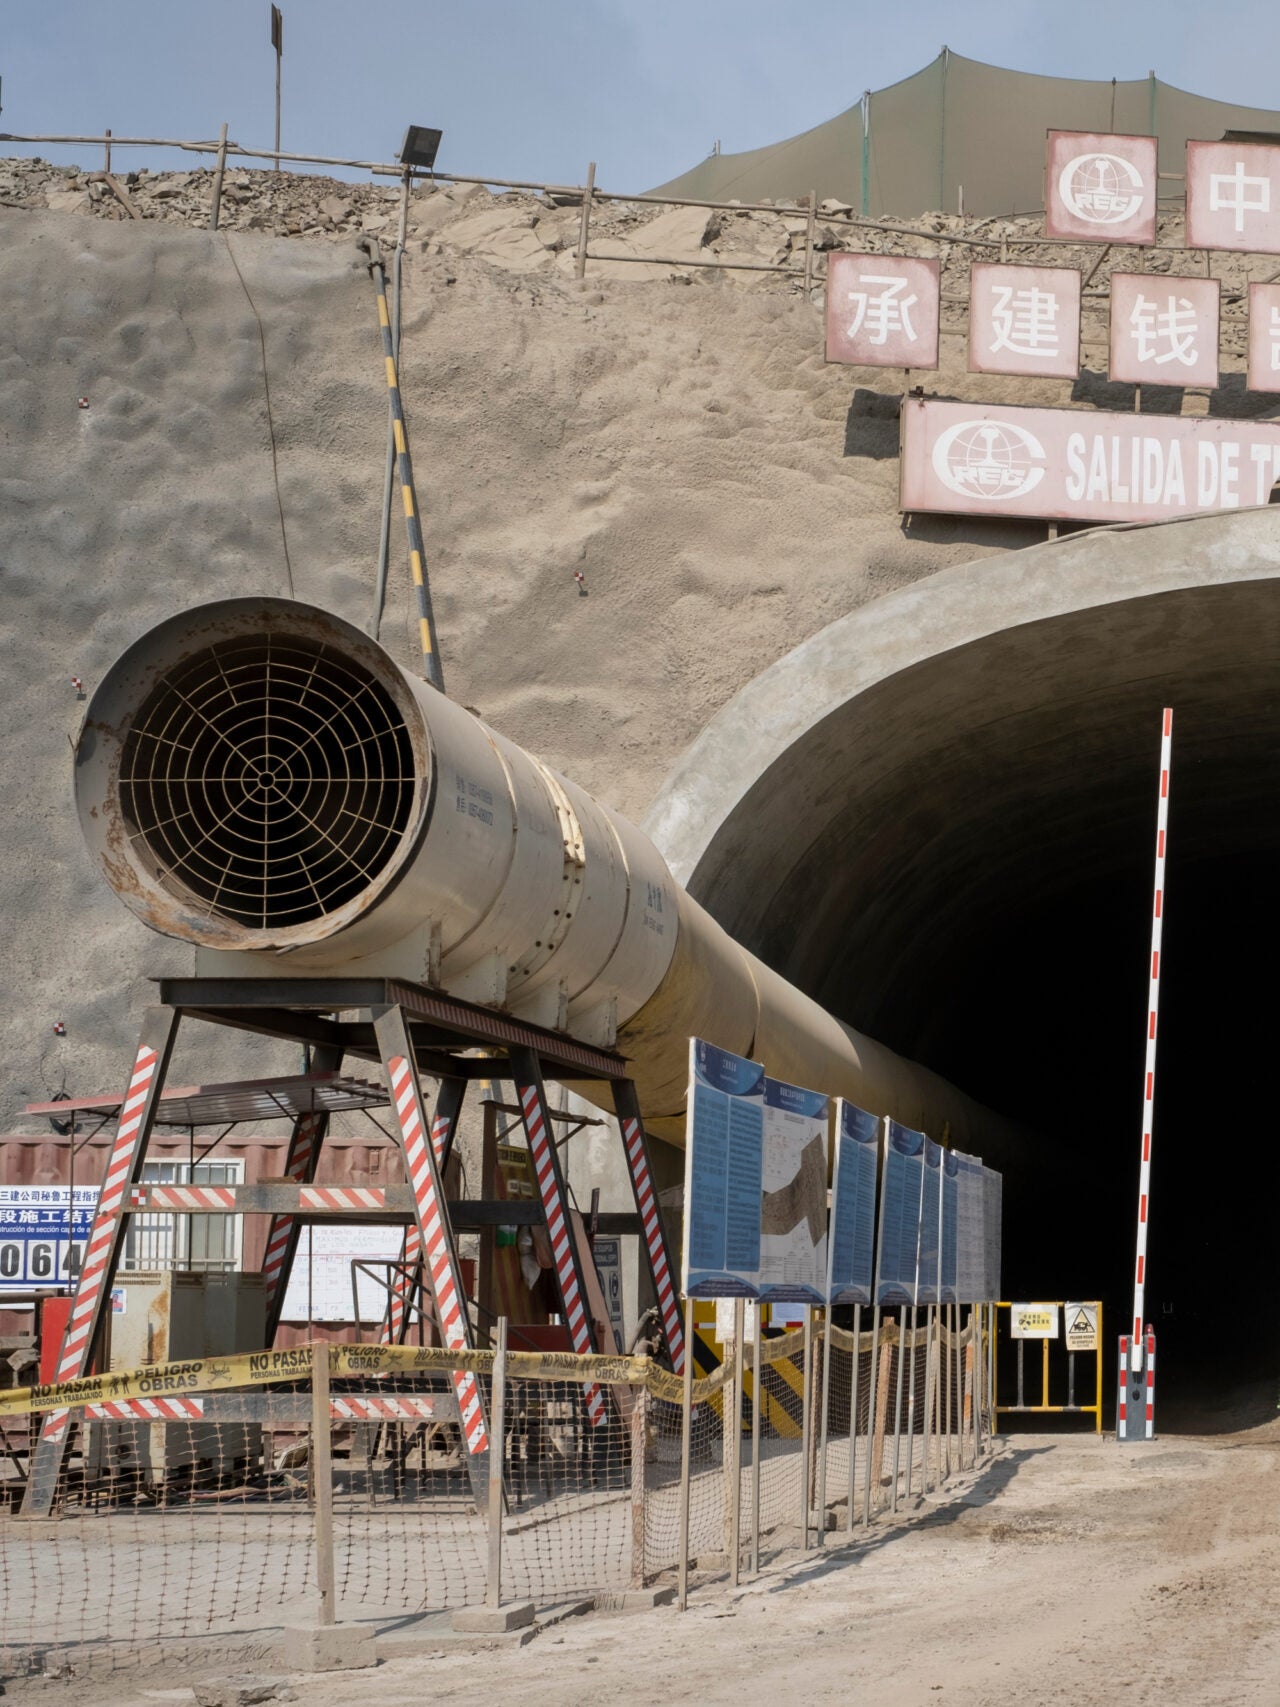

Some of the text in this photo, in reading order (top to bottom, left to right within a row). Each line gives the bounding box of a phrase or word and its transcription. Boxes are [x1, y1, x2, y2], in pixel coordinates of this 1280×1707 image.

[1065, 432, 1186, 506] SALIDA
[1196, 441, 1240, 508] DE
[342, 1346, 389, 1357] PELIGRO
[415, 1348, 460, 1361] NO PASAR
[249, 1354, 269, 1371] NO
[347, 1356, 381, 1369] OBRAS
[541, 1354, 580, 1370] NO PASAR
[593, 1357, 631, 1370] PELIGRO
[134, 1362, 203, 1380] PELIGRO
[250, 1370, 281, 1380] PERSONAS
[595, 1368, 630, 1381] OBRAS
[30, 1378, 102, 1398] NO PASAR
[139, 1374, 199, 1393] OBRAS
[30, 1391, 104, 1408] PERSONAS TRABAJANDO
